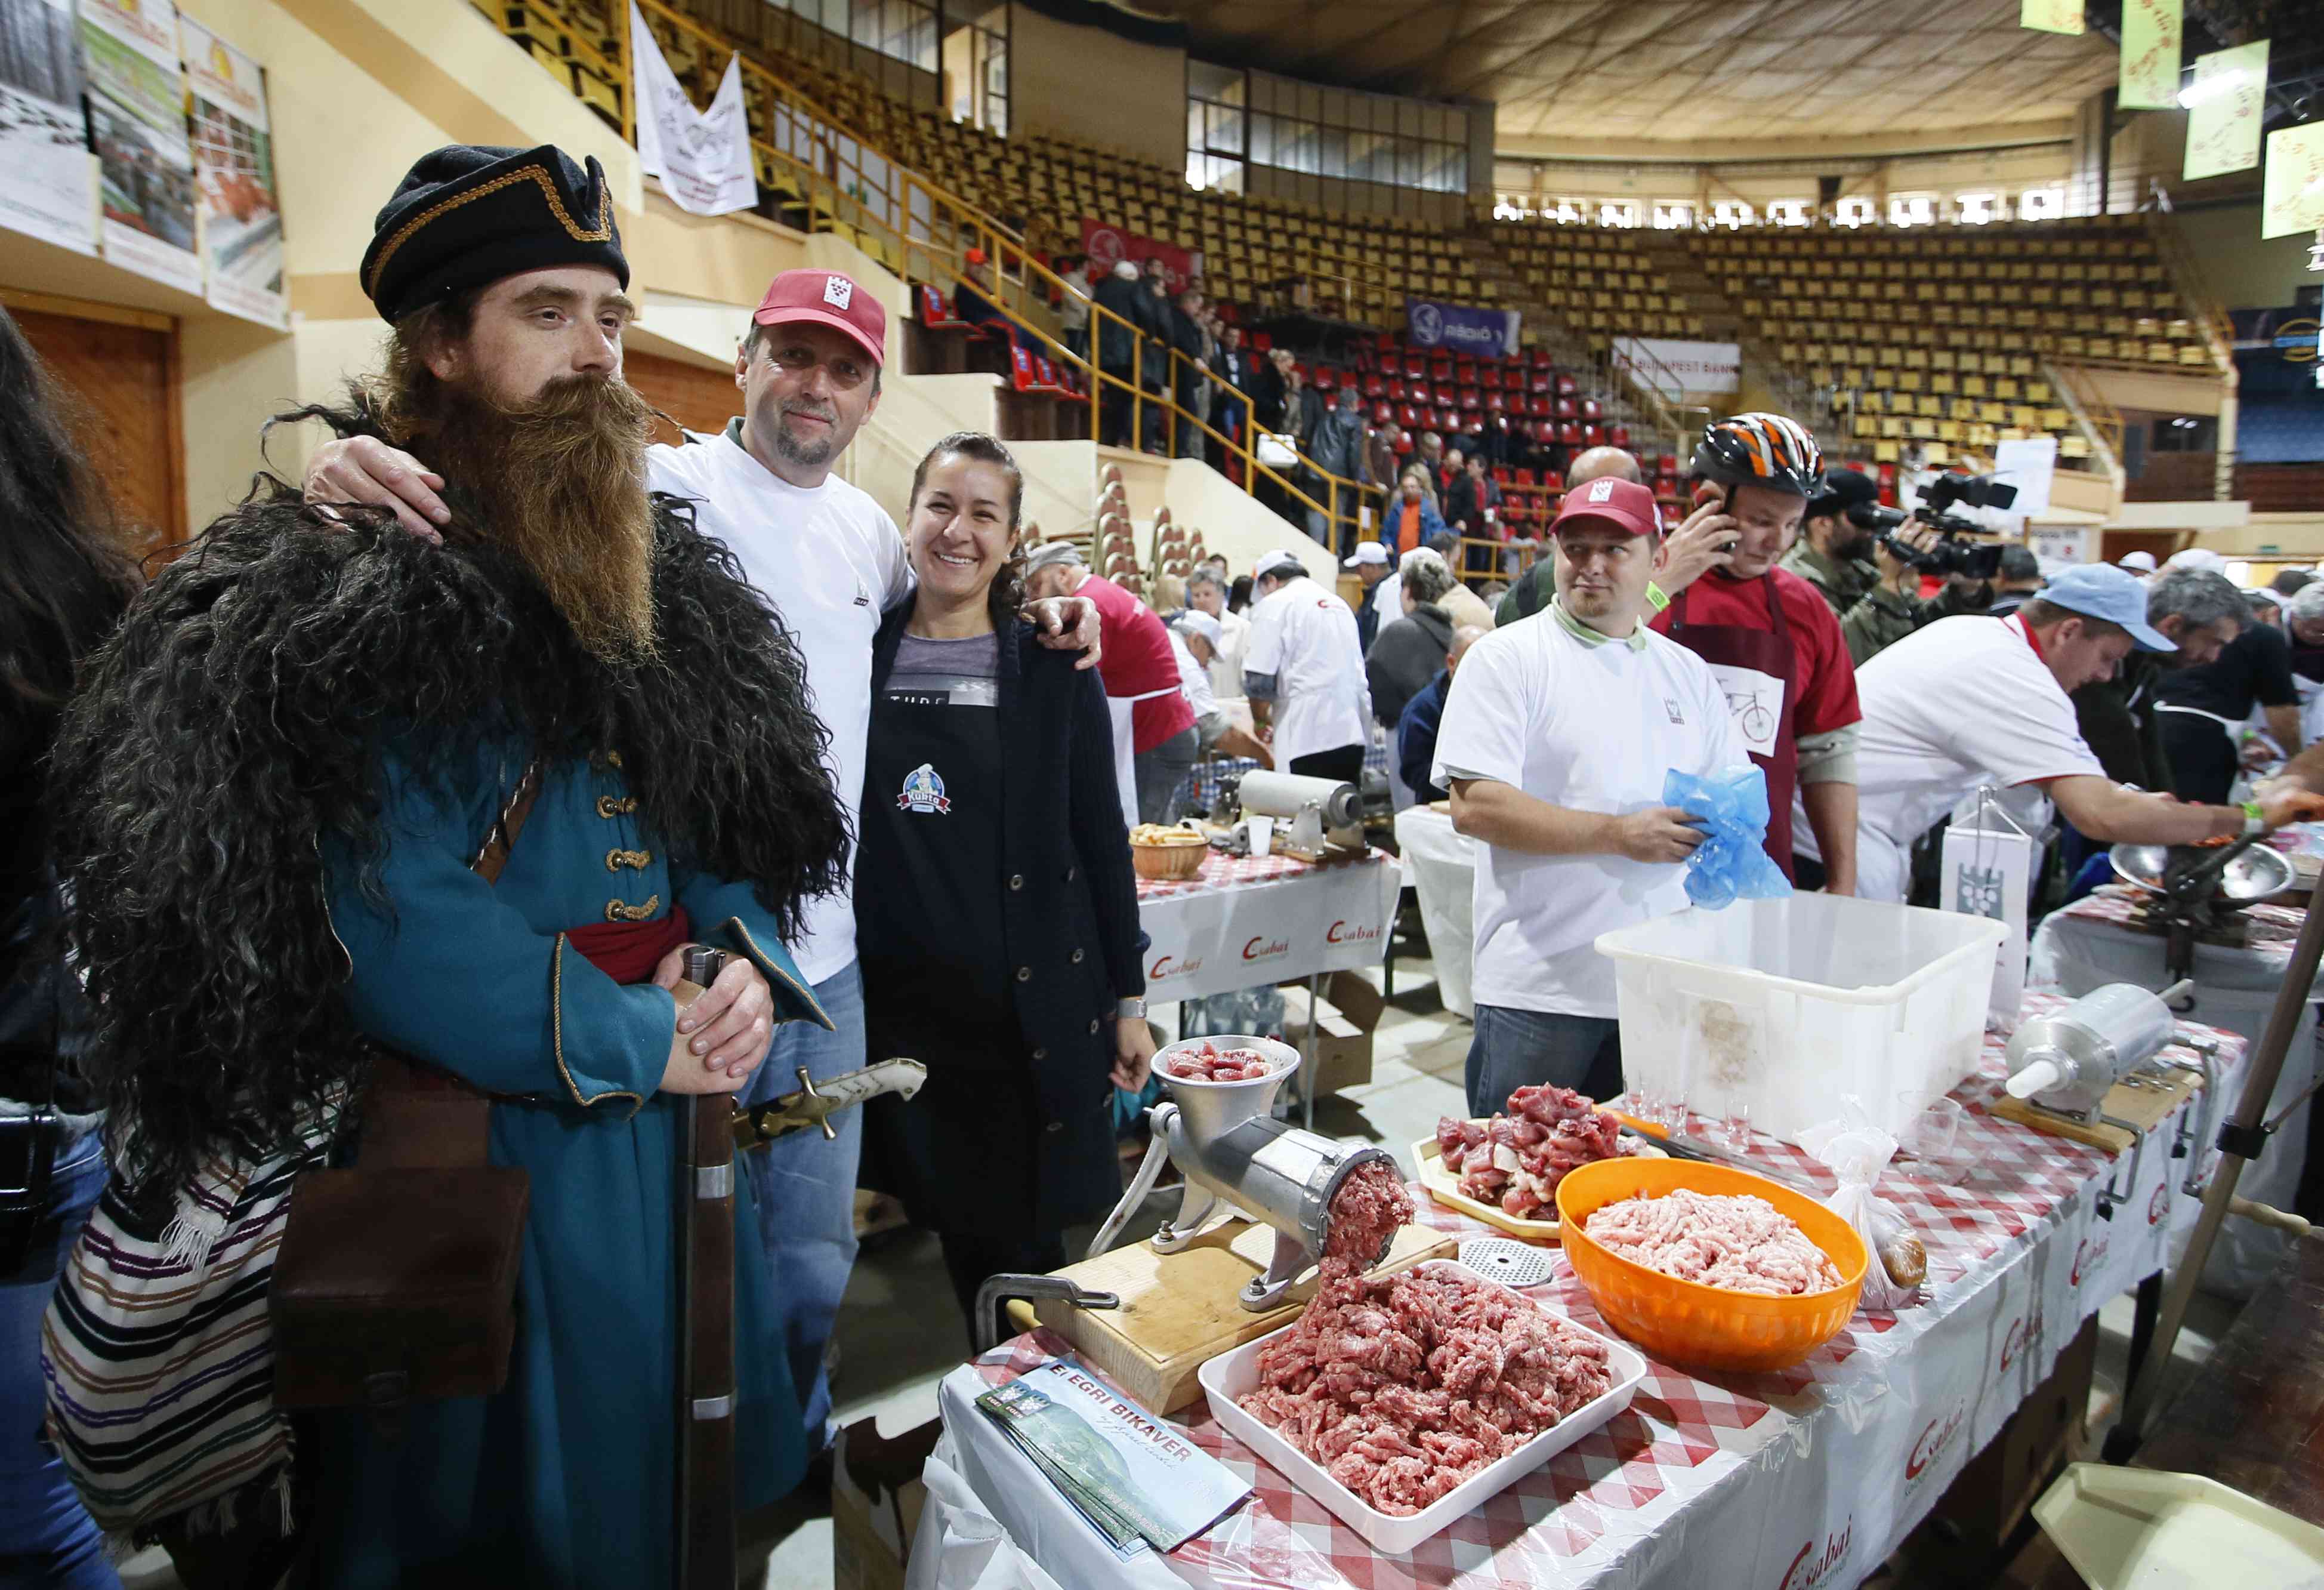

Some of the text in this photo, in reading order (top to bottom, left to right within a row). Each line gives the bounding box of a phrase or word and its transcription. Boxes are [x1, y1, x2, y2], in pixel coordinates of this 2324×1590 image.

[907, 791, 940, 805] Kukta
[1326, 920, 1381, 944] Csabai
[1242, 936, 1289, 960] Csabai
[1150, 956, 1202, 979] Csabai
[1067, 1374, 1113, 1404] EGRI
[1110, 1403, 1193, 1462] BIKAVÉR
